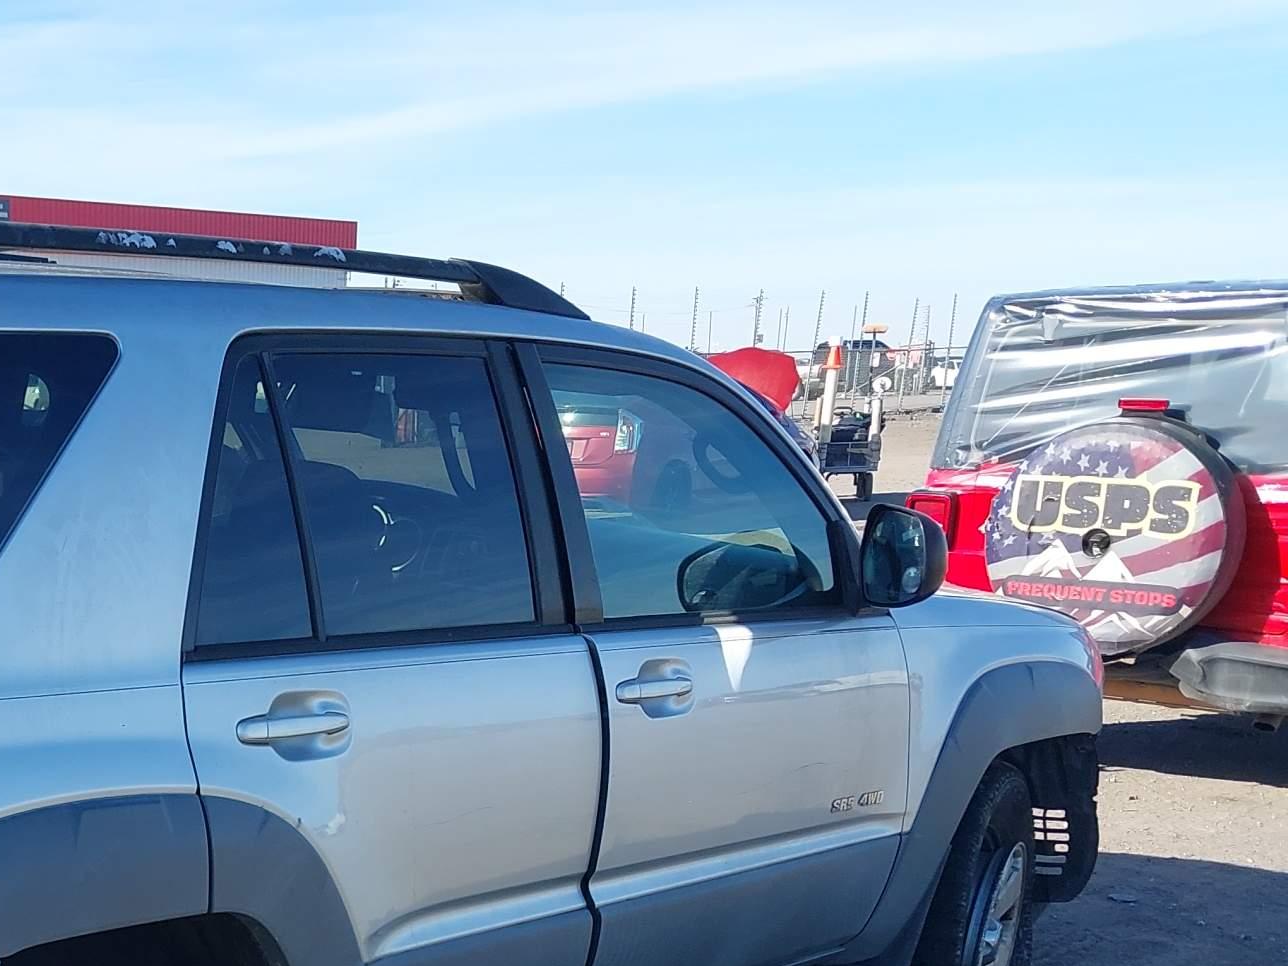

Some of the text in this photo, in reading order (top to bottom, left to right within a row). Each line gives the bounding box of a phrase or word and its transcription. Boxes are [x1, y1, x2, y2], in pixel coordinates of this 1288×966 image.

[1012, 474, 1202, 539] USPS
[1006, 581, 1177, 608] FREQUENT STOPS
[831, 790, 885, 813] SR5 4WD
